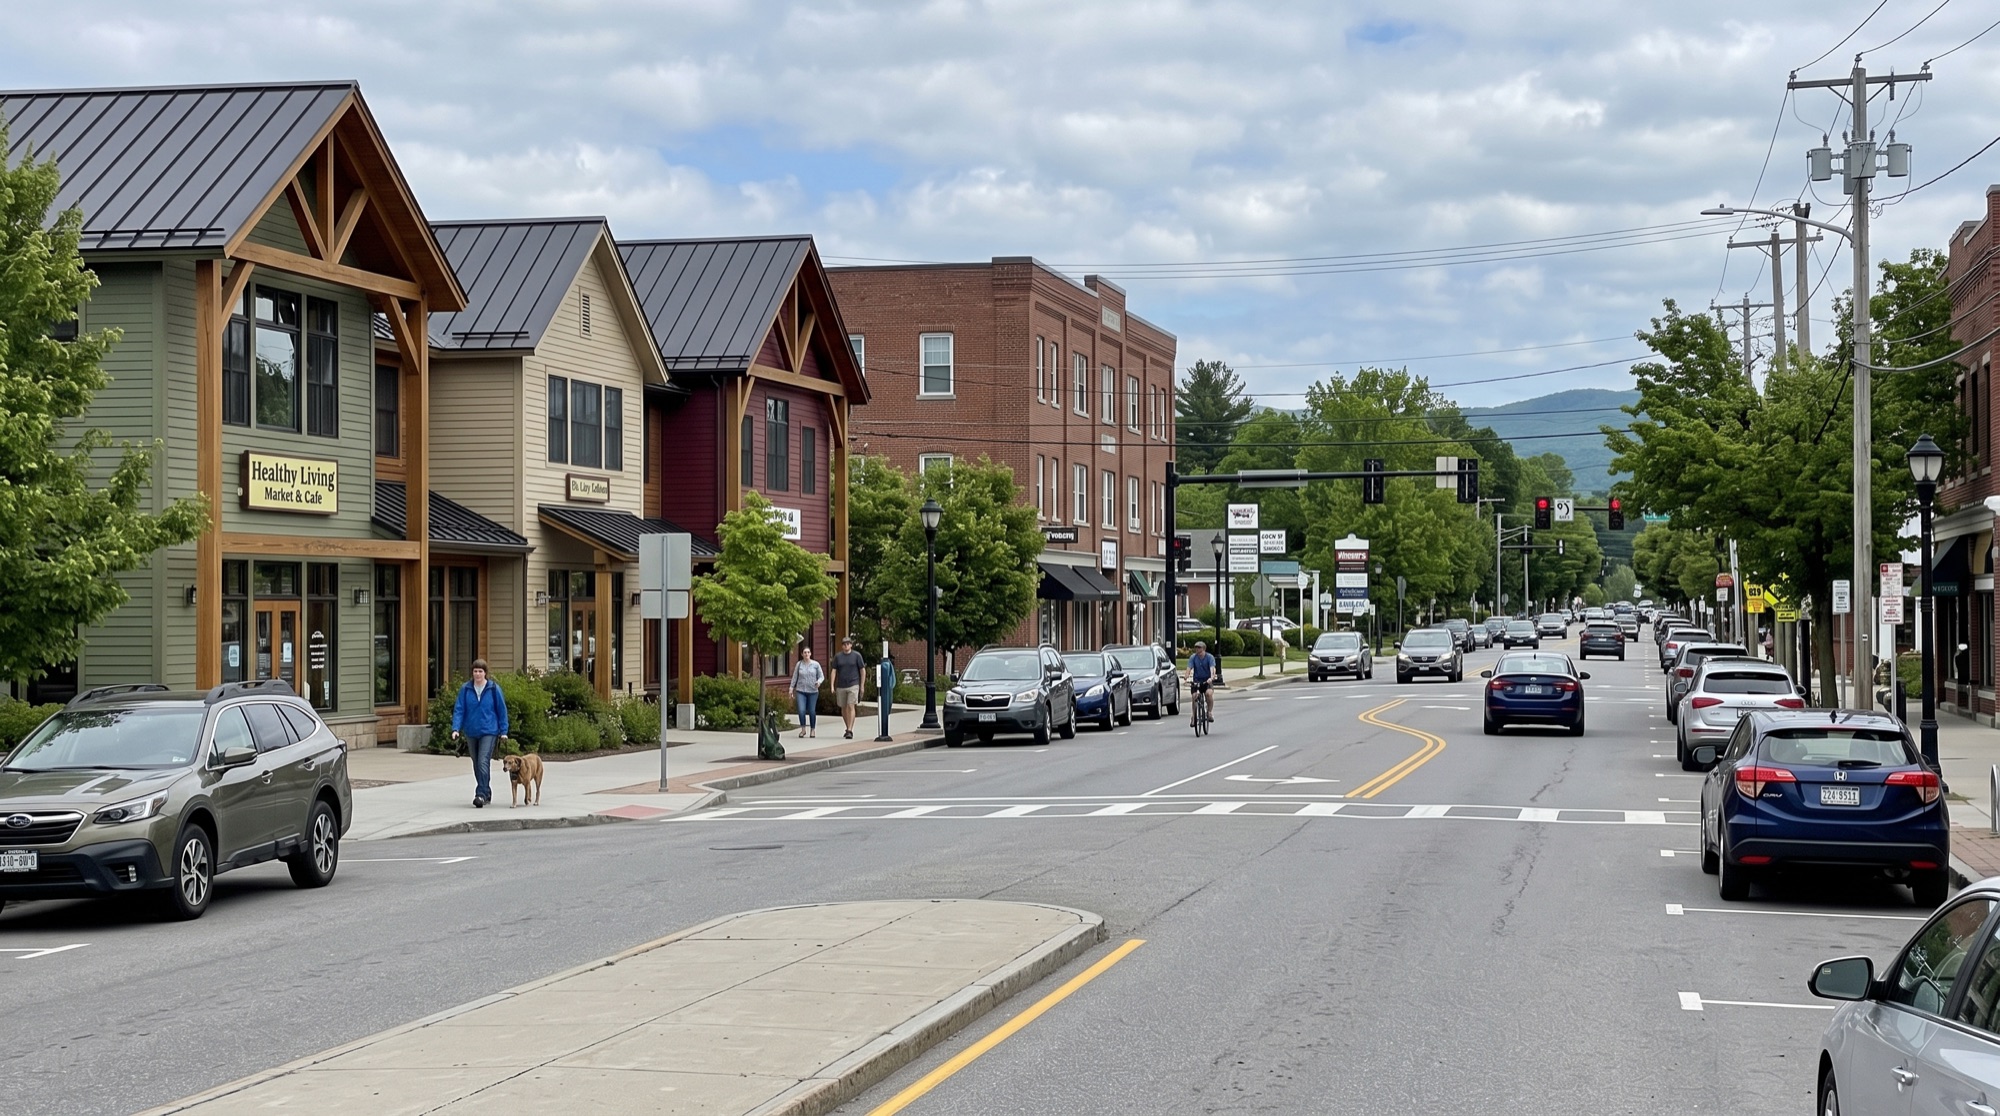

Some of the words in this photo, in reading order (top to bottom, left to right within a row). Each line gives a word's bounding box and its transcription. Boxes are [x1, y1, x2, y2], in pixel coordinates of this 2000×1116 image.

[251, 461, 298, 488] Healthy
[300, 466, 335, 492] Living
[264, 487, 293, 502] Market
[295, 491, 303, 503] &
[305, 491, 322, 505] Cafe
